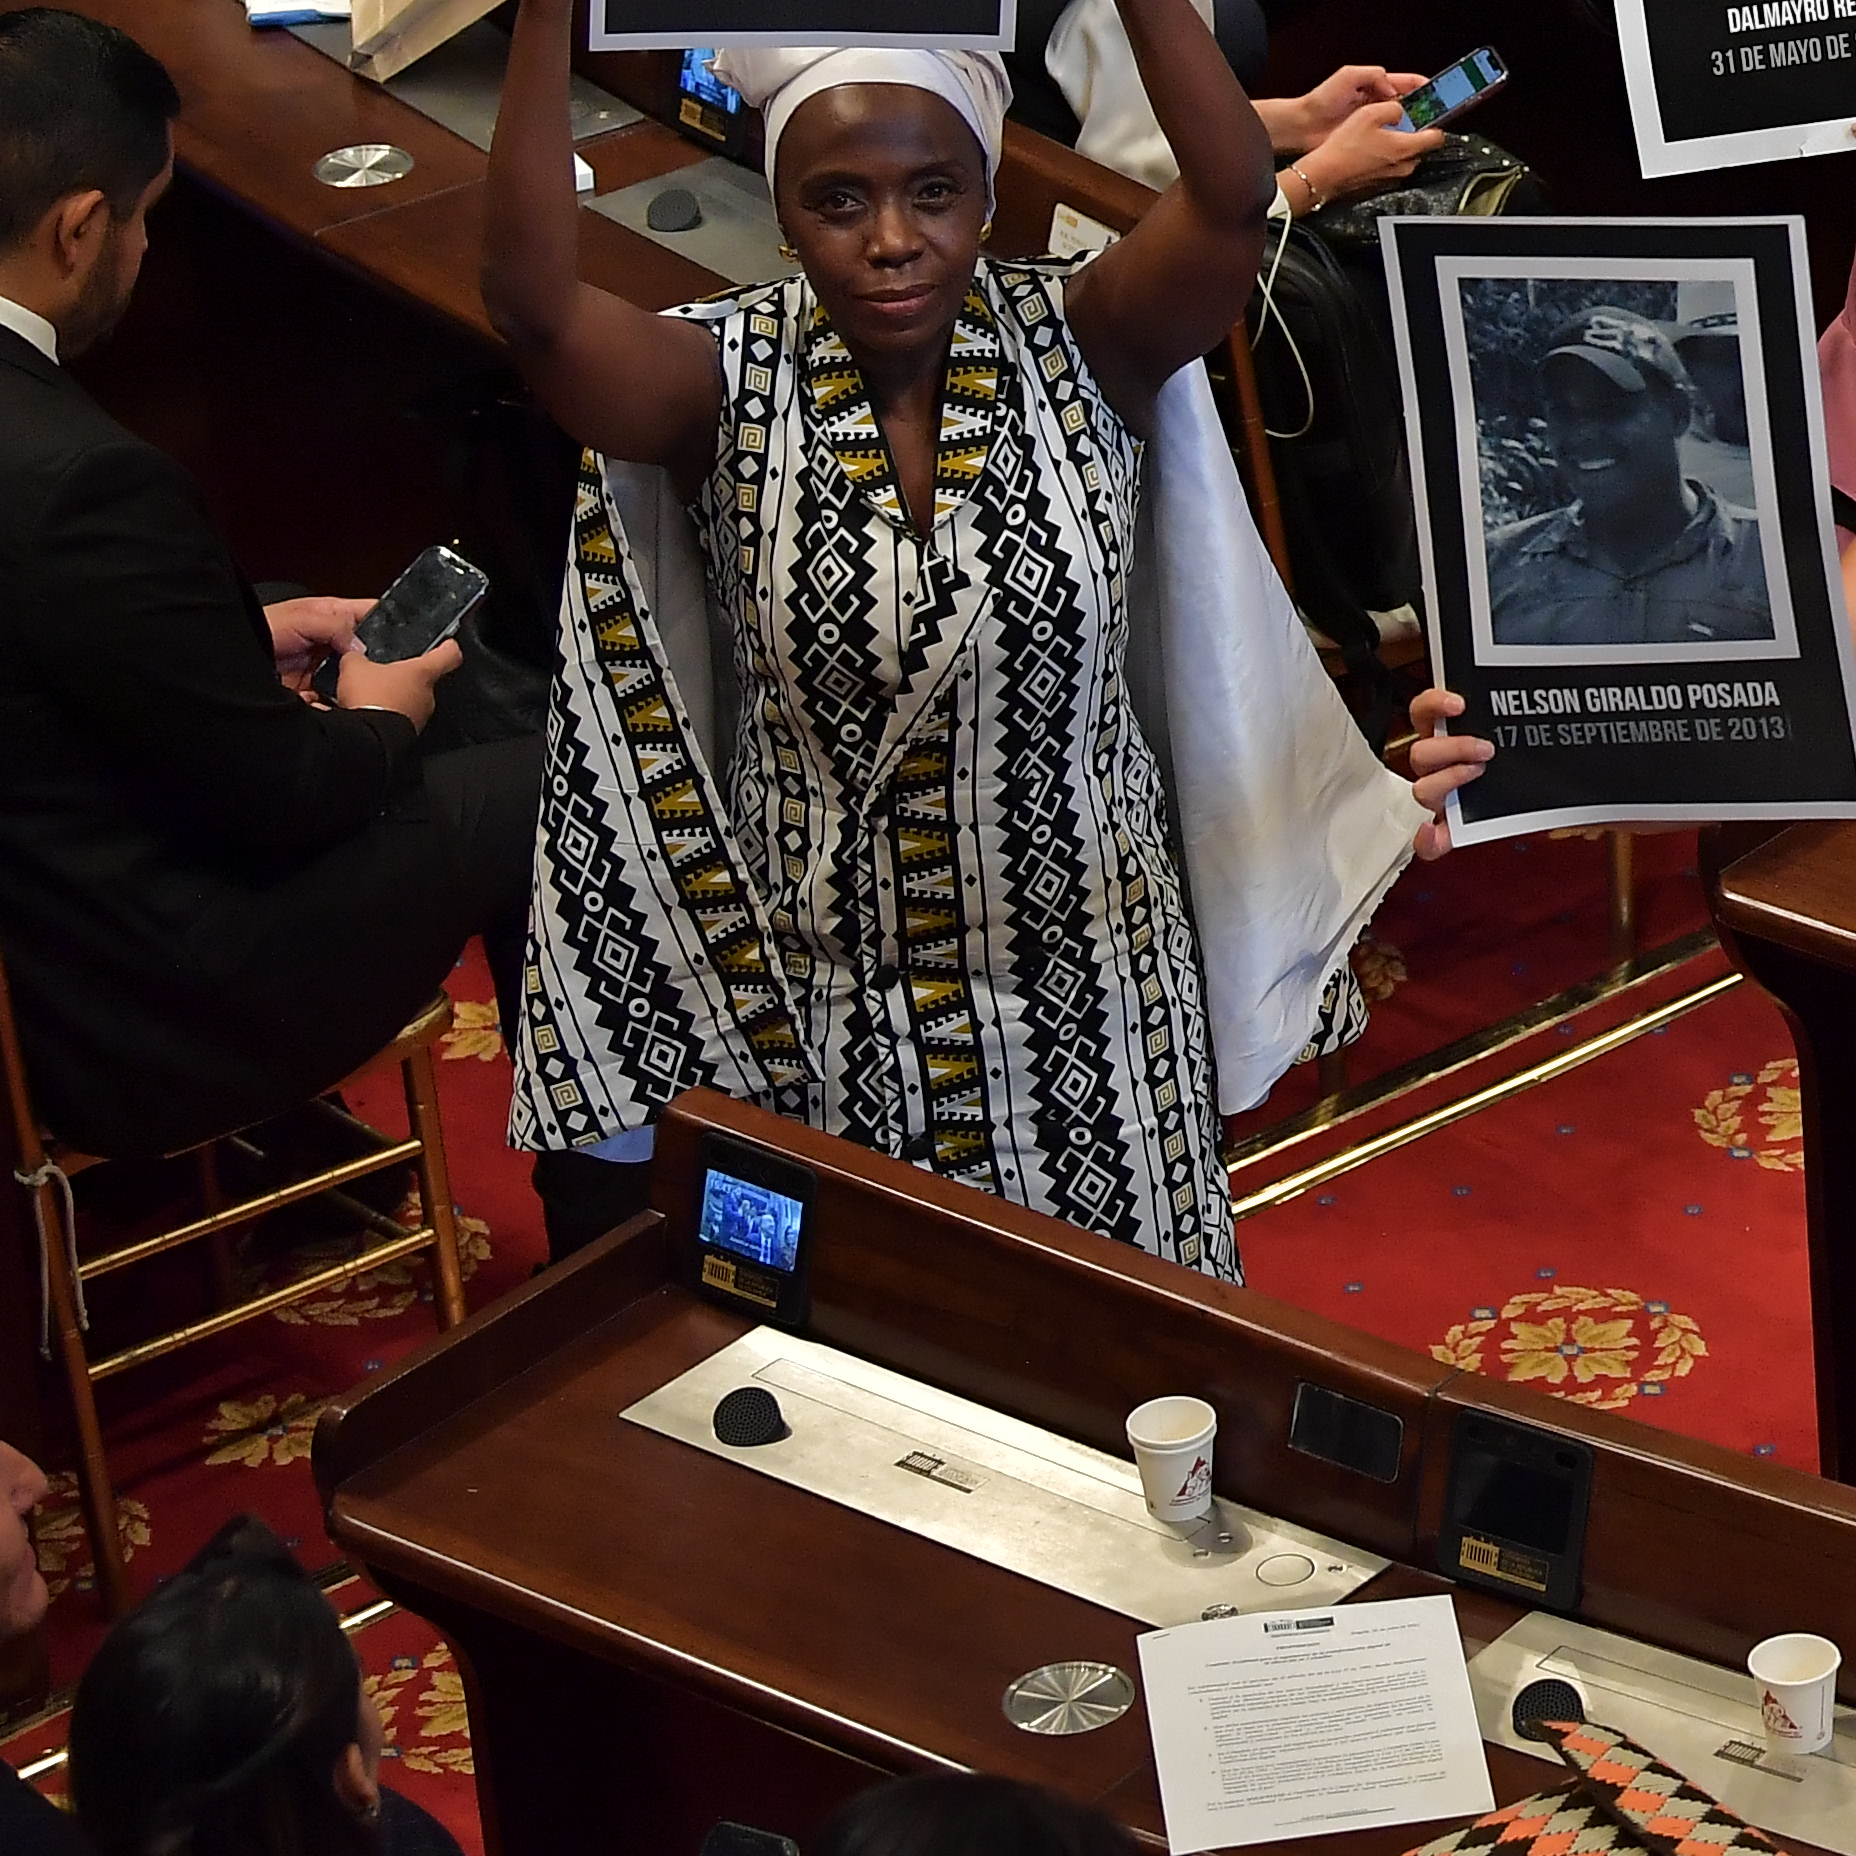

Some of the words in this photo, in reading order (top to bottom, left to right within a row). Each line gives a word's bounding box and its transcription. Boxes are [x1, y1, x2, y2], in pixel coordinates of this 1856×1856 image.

[1711, 49, 1736, 75] 31
[1740, 45, 1766, 72] DE
[1768, 37, 1822, 68] MAYO
[1825, 33, 1852, 60] DE
[1490, 689, 1581, 716] NELSON
[1585, 685, 1682, 713] GIRALDO
[1687, 681, 1781, 709] POSADA
[1494, 725, 1518, 747] 17
[1525, 724, 1553, 747] DE
[1557, 718, 1691, 745] SEPTIEMBRE
[1695, 718, 1728, 741] DE
[1729, 716, 1785, 740] 2013
